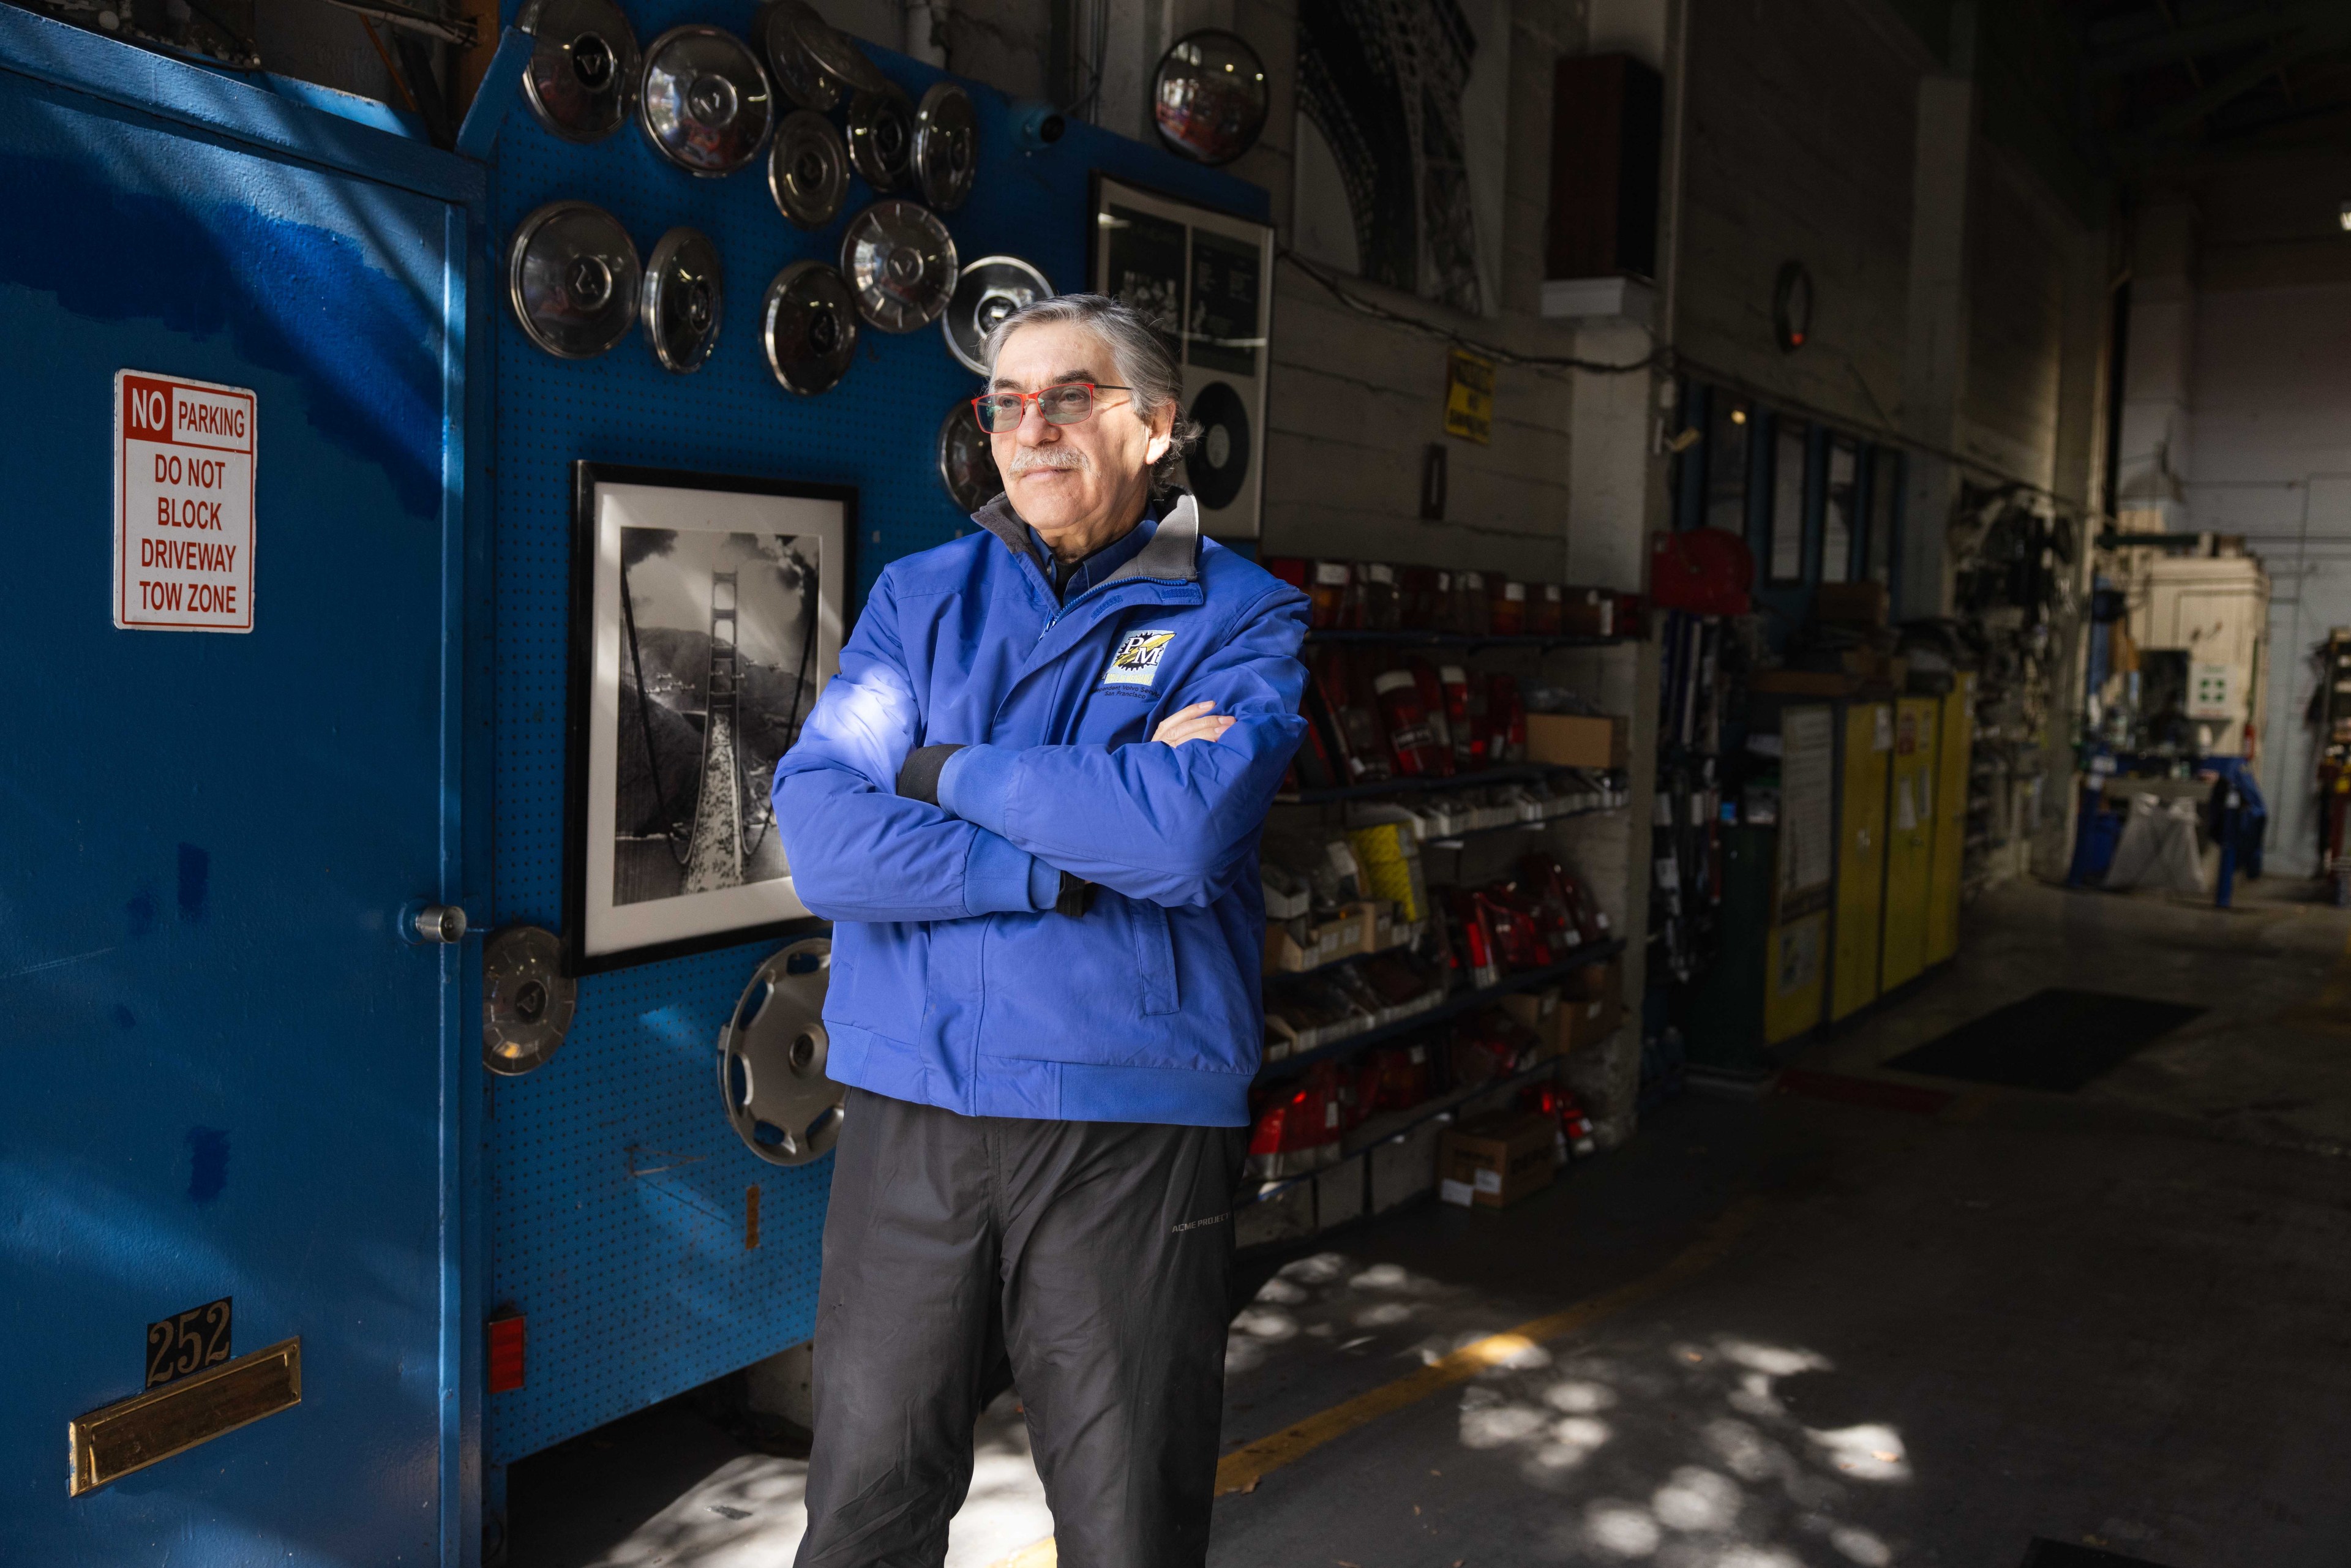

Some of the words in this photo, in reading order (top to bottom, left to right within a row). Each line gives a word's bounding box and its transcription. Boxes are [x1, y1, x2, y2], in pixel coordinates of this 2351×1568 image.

[132, 388, 166, 431] NO
[178, 400, 245, 438] PARKING
[155, 454, 182, 485] DO
[188, 458, 226, 490] NOT
[157, 497, 222, 531] BLOCK
[141, 538, 236, 572] DRIVEWAY
[139, 581, 182, 611] TOW
[187, 583, 236, 613] ZONE
[1116, 690, 1146, 699] Francisco
[1141, 686, 1161, 699] Servic
[1172, 1221, 1196, 1233] ACME
[148, 1300, 230, 1387] 252
